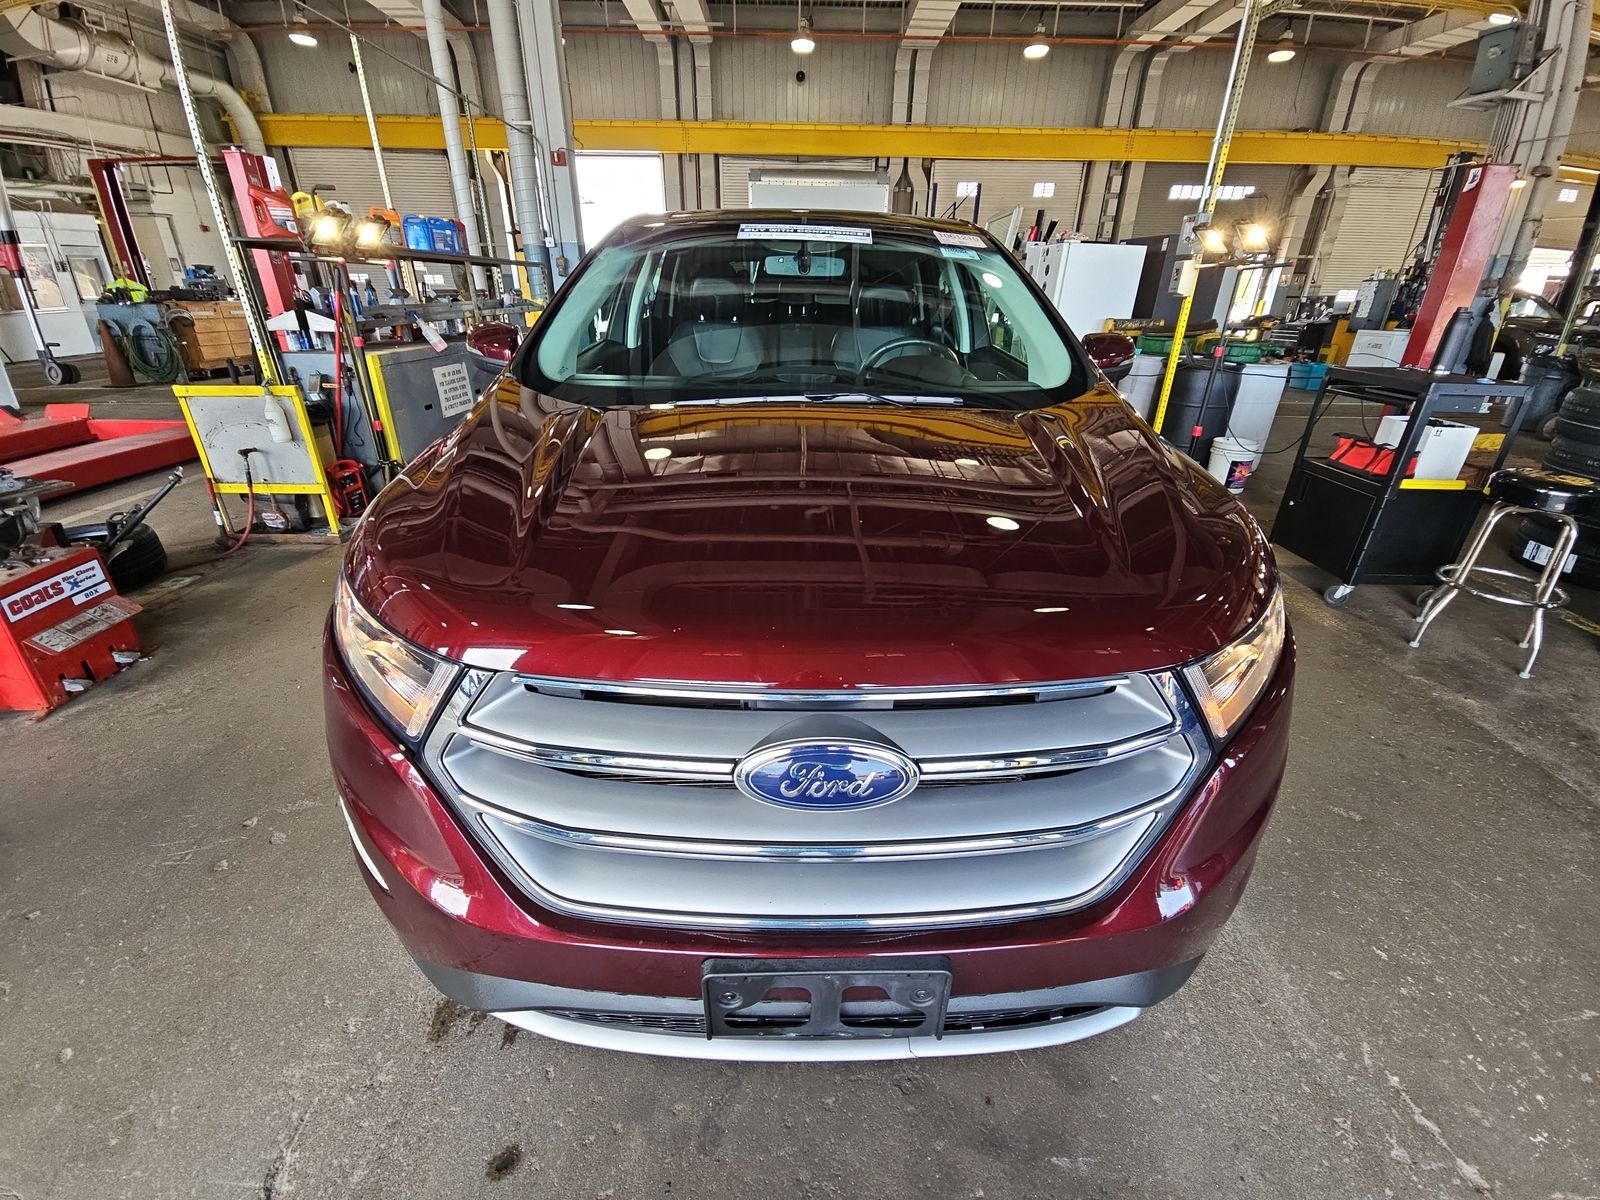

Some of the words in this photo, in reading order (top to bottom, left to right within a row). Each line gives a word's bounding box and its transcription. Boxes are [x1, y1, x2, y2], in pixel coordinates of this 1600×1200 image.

[61, 574, 75, 582] Rim
[75, 565, 96, 577] Clamp
[780, 761, 876, 798] Ford
